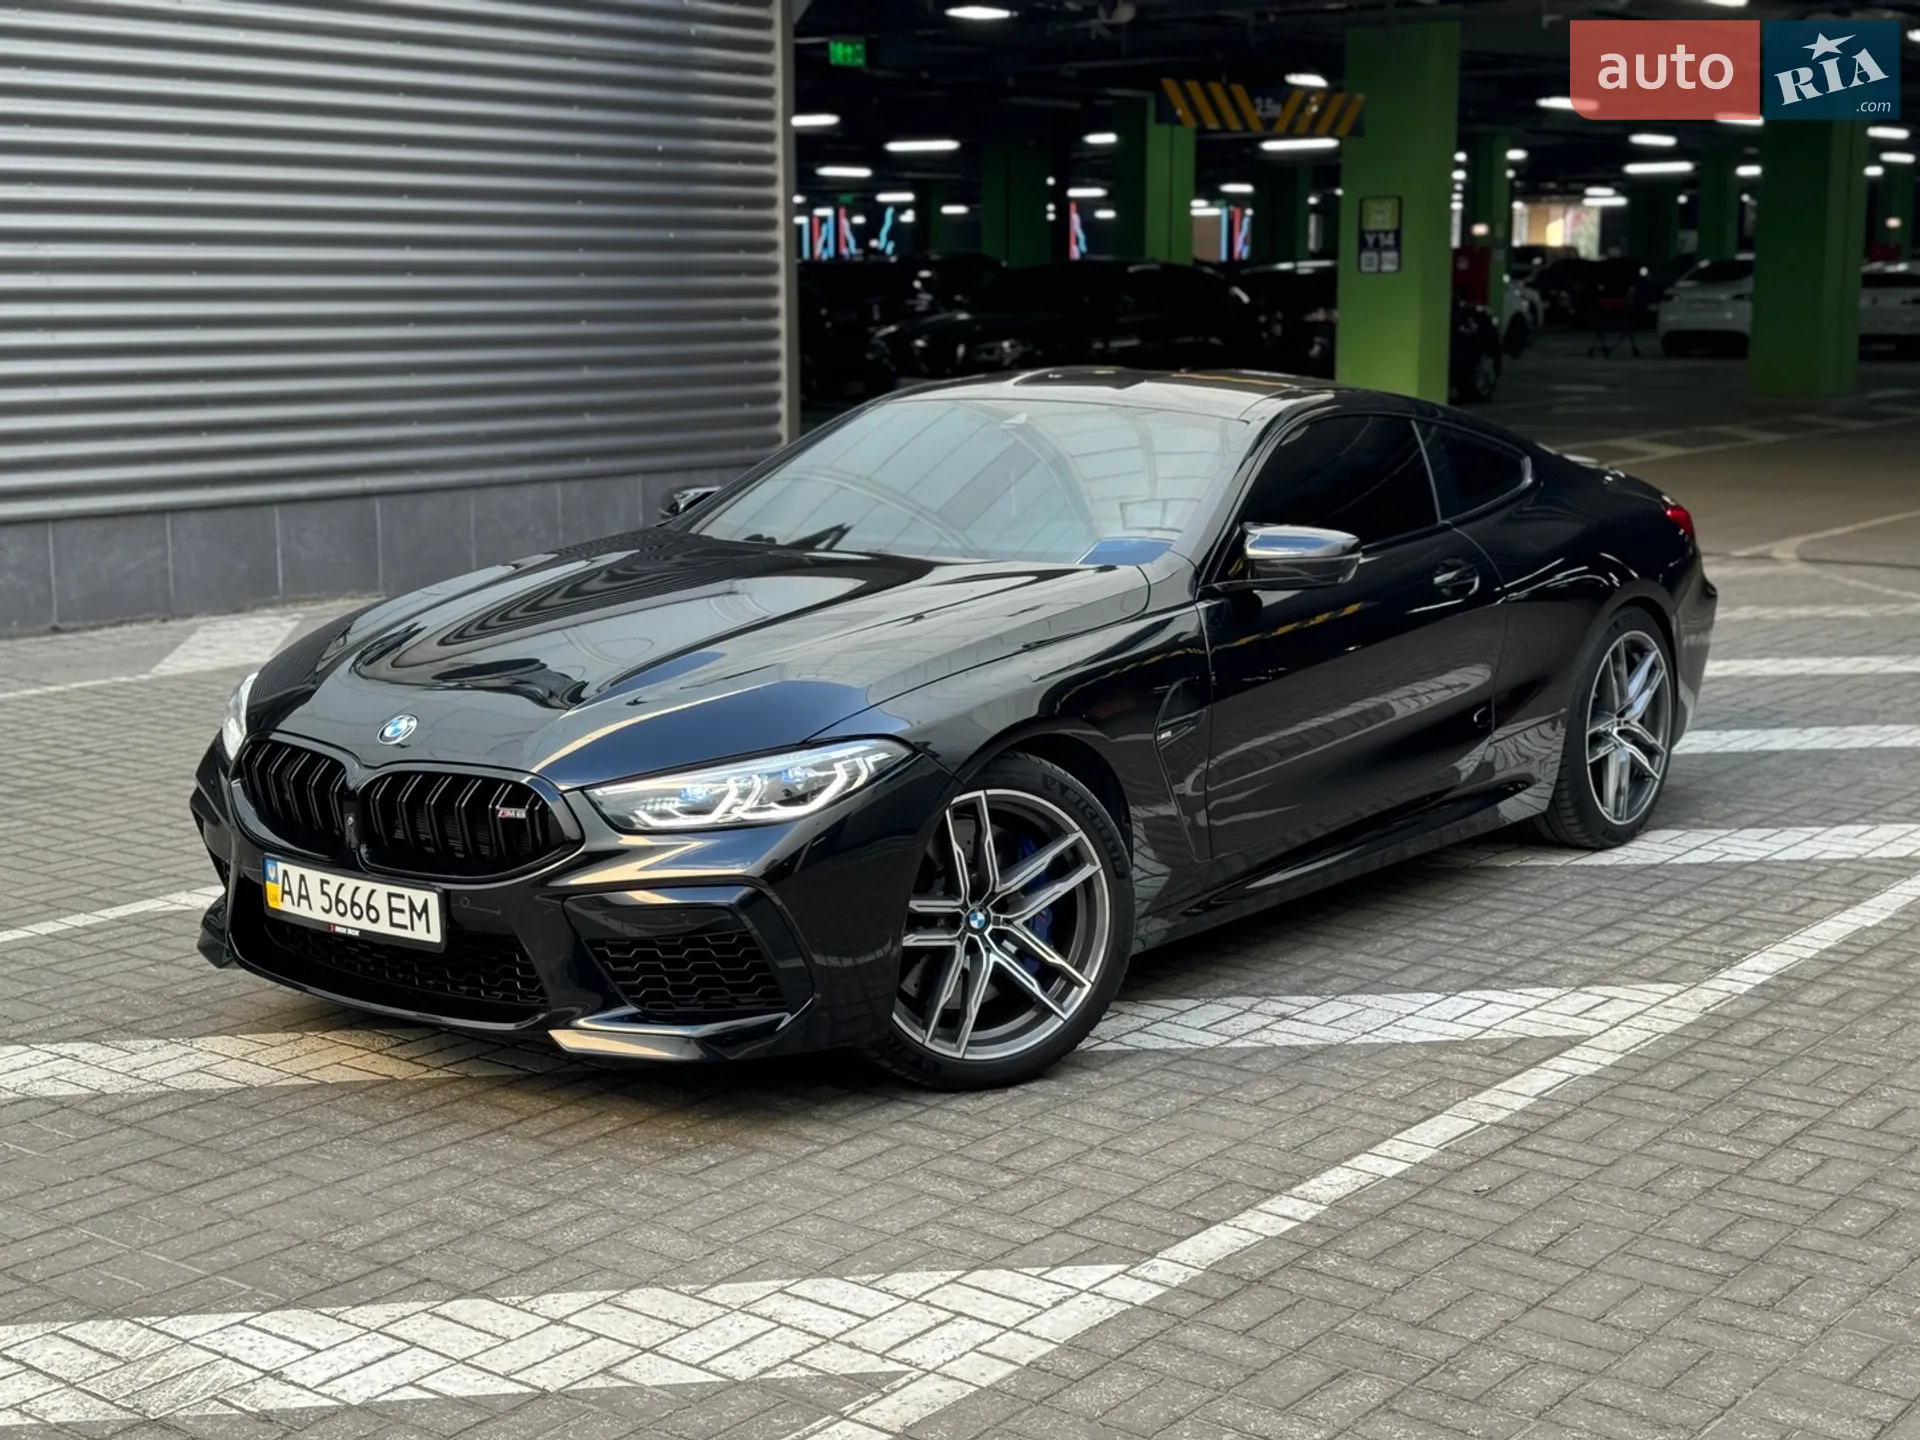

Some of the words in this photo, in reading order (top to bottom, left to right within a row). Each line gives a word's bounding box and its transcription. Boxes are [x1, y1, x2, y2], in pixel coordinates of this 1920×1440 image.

[1064, 787, 1126, 879] MICHELIN
[281, 869, 312, 911] AA
[320, 878, 380, 924] 5666
[387, 892, 431, 934] EM
